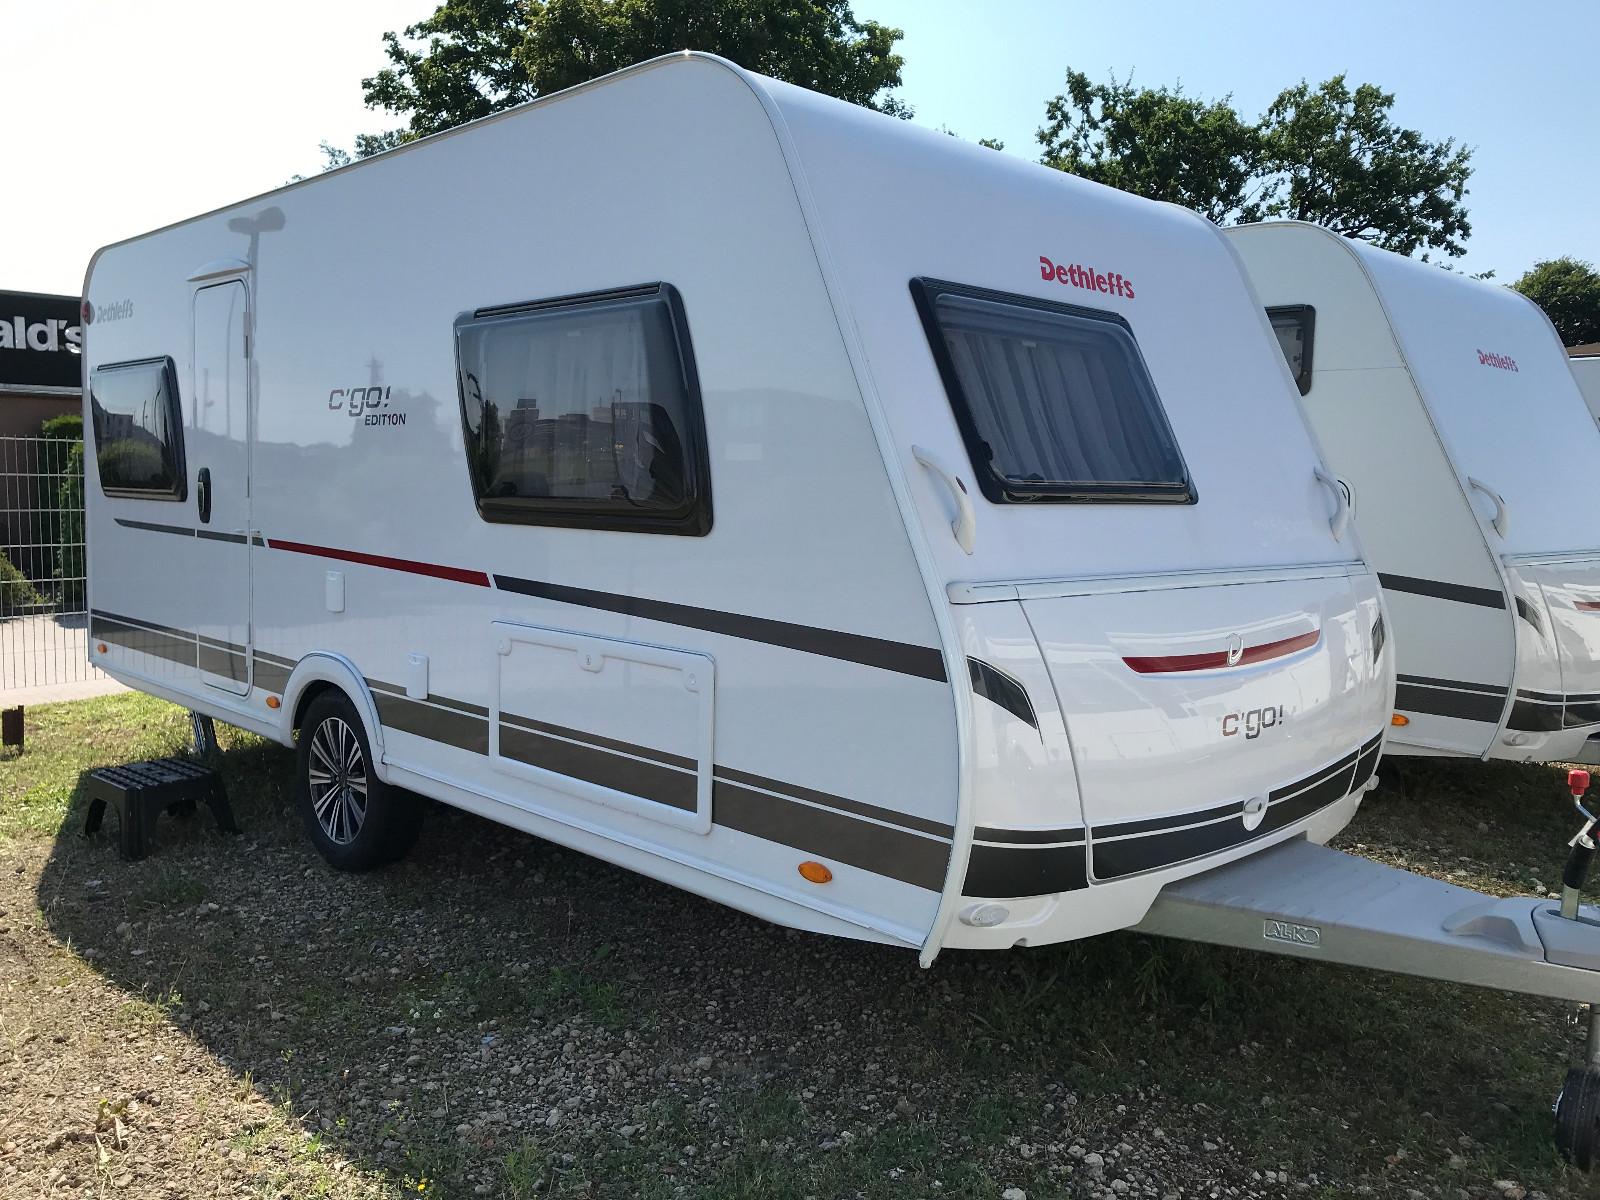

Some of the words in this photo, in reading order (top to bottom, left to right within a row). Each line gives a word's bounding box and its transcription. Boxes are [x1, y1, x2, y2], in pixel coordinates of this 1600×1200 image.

[1039, 255, 1135, 299] Dethleffs
[97, 299, 134, 324] Dethleffs
[1476, 349, 1519, 373] Dethleffs
